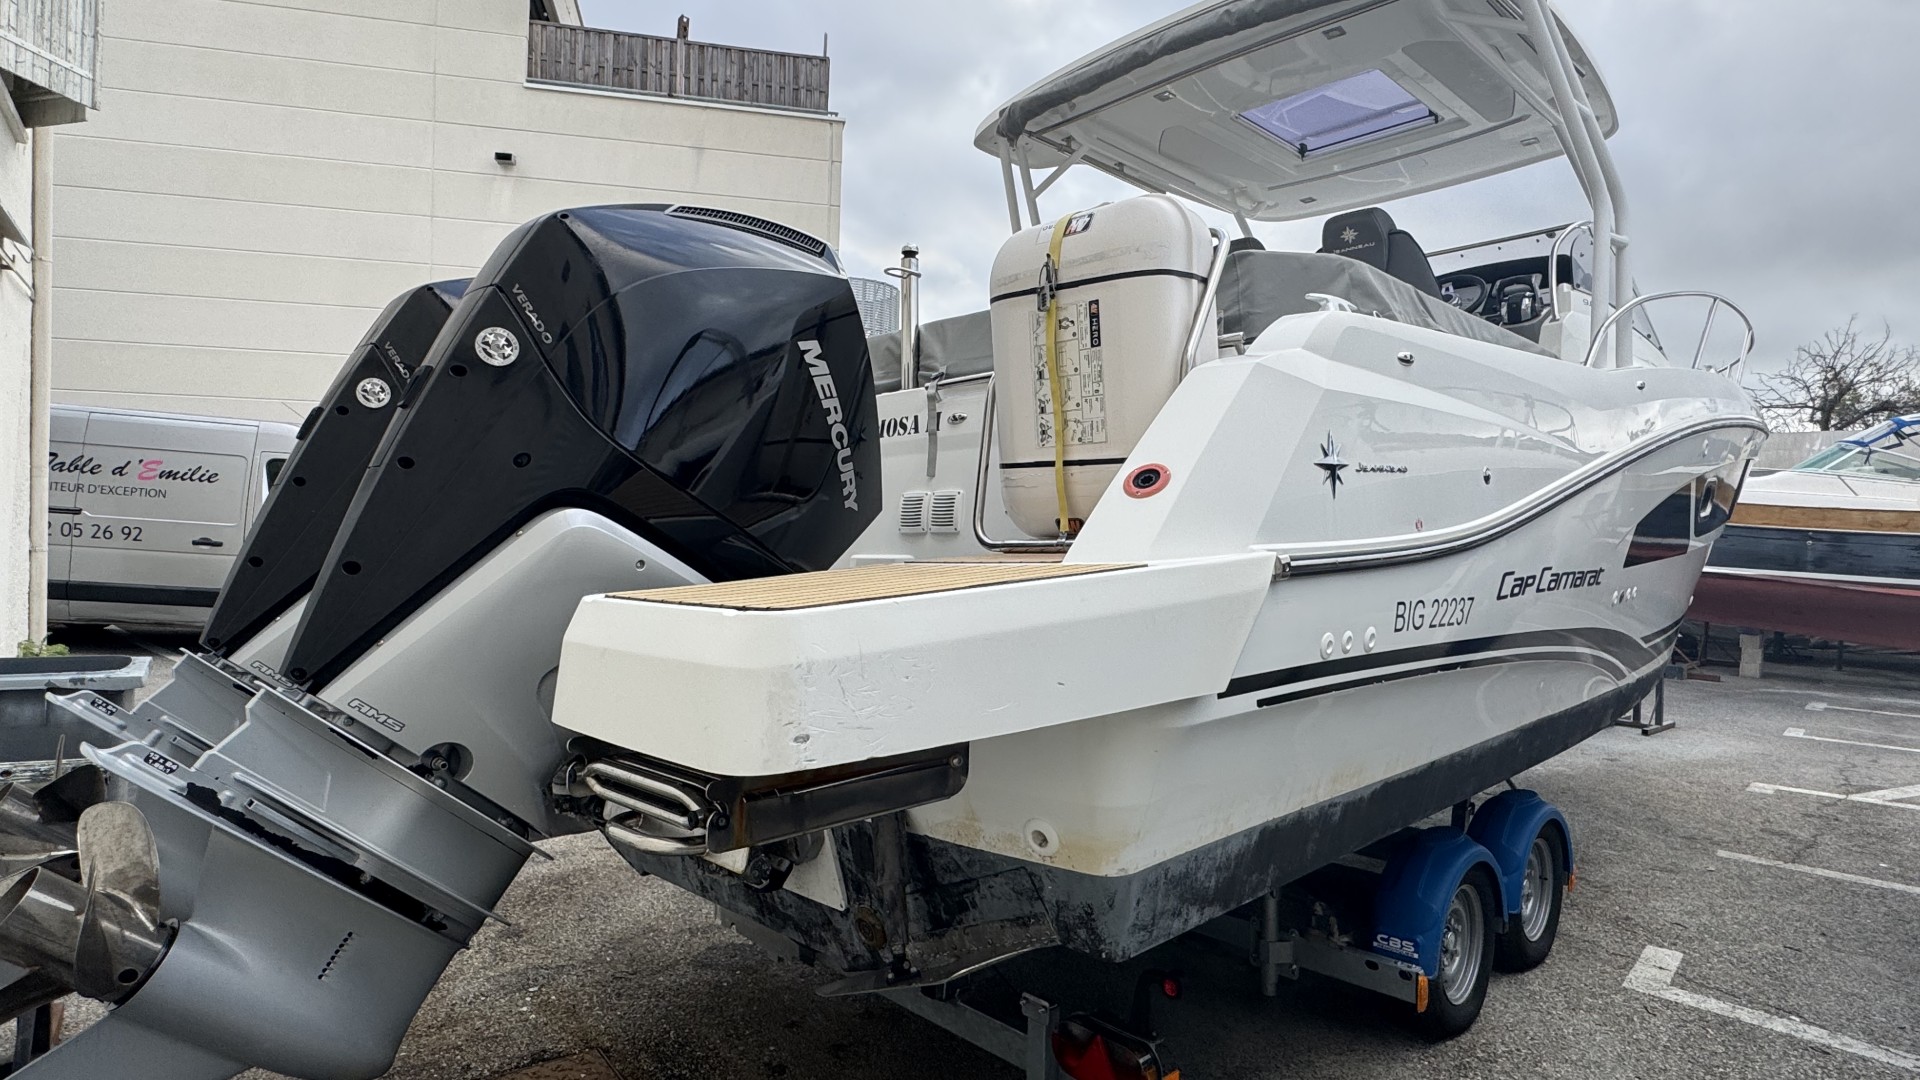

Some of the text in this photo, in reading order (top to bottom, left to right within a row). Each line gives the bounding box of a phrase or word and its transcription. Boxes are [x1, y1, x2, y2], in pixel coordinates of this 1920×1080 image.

[512, 283, 552, 344] VERADO
[1091, 317, 1100, 346] HERO
[385, 341, 411, 384] VERAD
[797, 339, 859, 511] MERCURY
[112, 459, 219, 483] d'Emilie
[88, 484, 167, 498] D'EXCEPTION
[60, 522, 83, 538] 05
[91, 524, 113, 540] 26
[121, 526, 143, 541] 92
[1535, 566, 1605, 593] Camarat
[1394, 597, 1475, 632] BIG 22237
[250, 660, 295, 688] AMS
[348, 698, 405, 732] AMS
[1376, 934, 1415, 952] CBS
